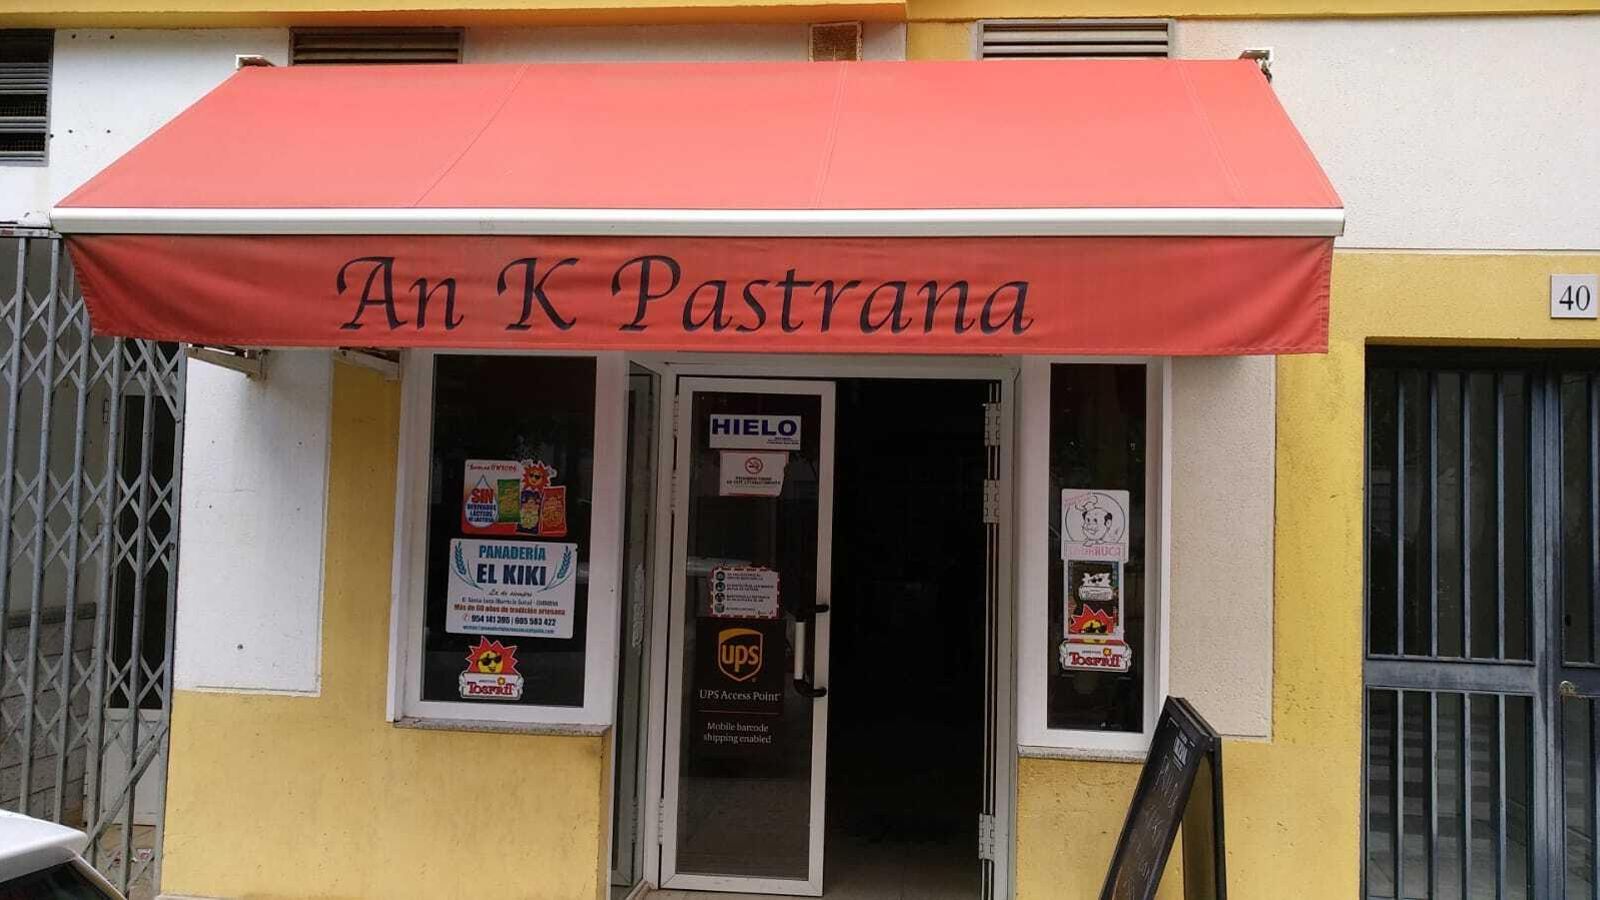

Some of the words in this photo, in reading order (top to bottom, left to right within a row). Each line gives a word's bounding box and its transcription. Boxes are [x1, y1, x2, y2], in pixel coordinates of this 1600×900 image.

[336, 256, 465, 330] An
[497, 257, 580, 331] K
[611, 254, 1034, 335] Pastrana
[1559, 285, 1591, 311] 40
[712, 418, 797, 436] HIELO
[471, 488, 494, 503] SIN
[479, 544, 546, 560] PANADERÍA
[477, 563, 498, 585] EL
[503, 564, 547, 586] KIKI
[721, 644, 760, 673] ups
[699, 688, 720, 700] UPS
[720, 690, 752, 701] Access
[707, 722, 736, 731] Mobile
[736, 723, 769, 733] barcode
[704, 733, 738, 744] shipping
[738, 735, 773, 744] enabled
